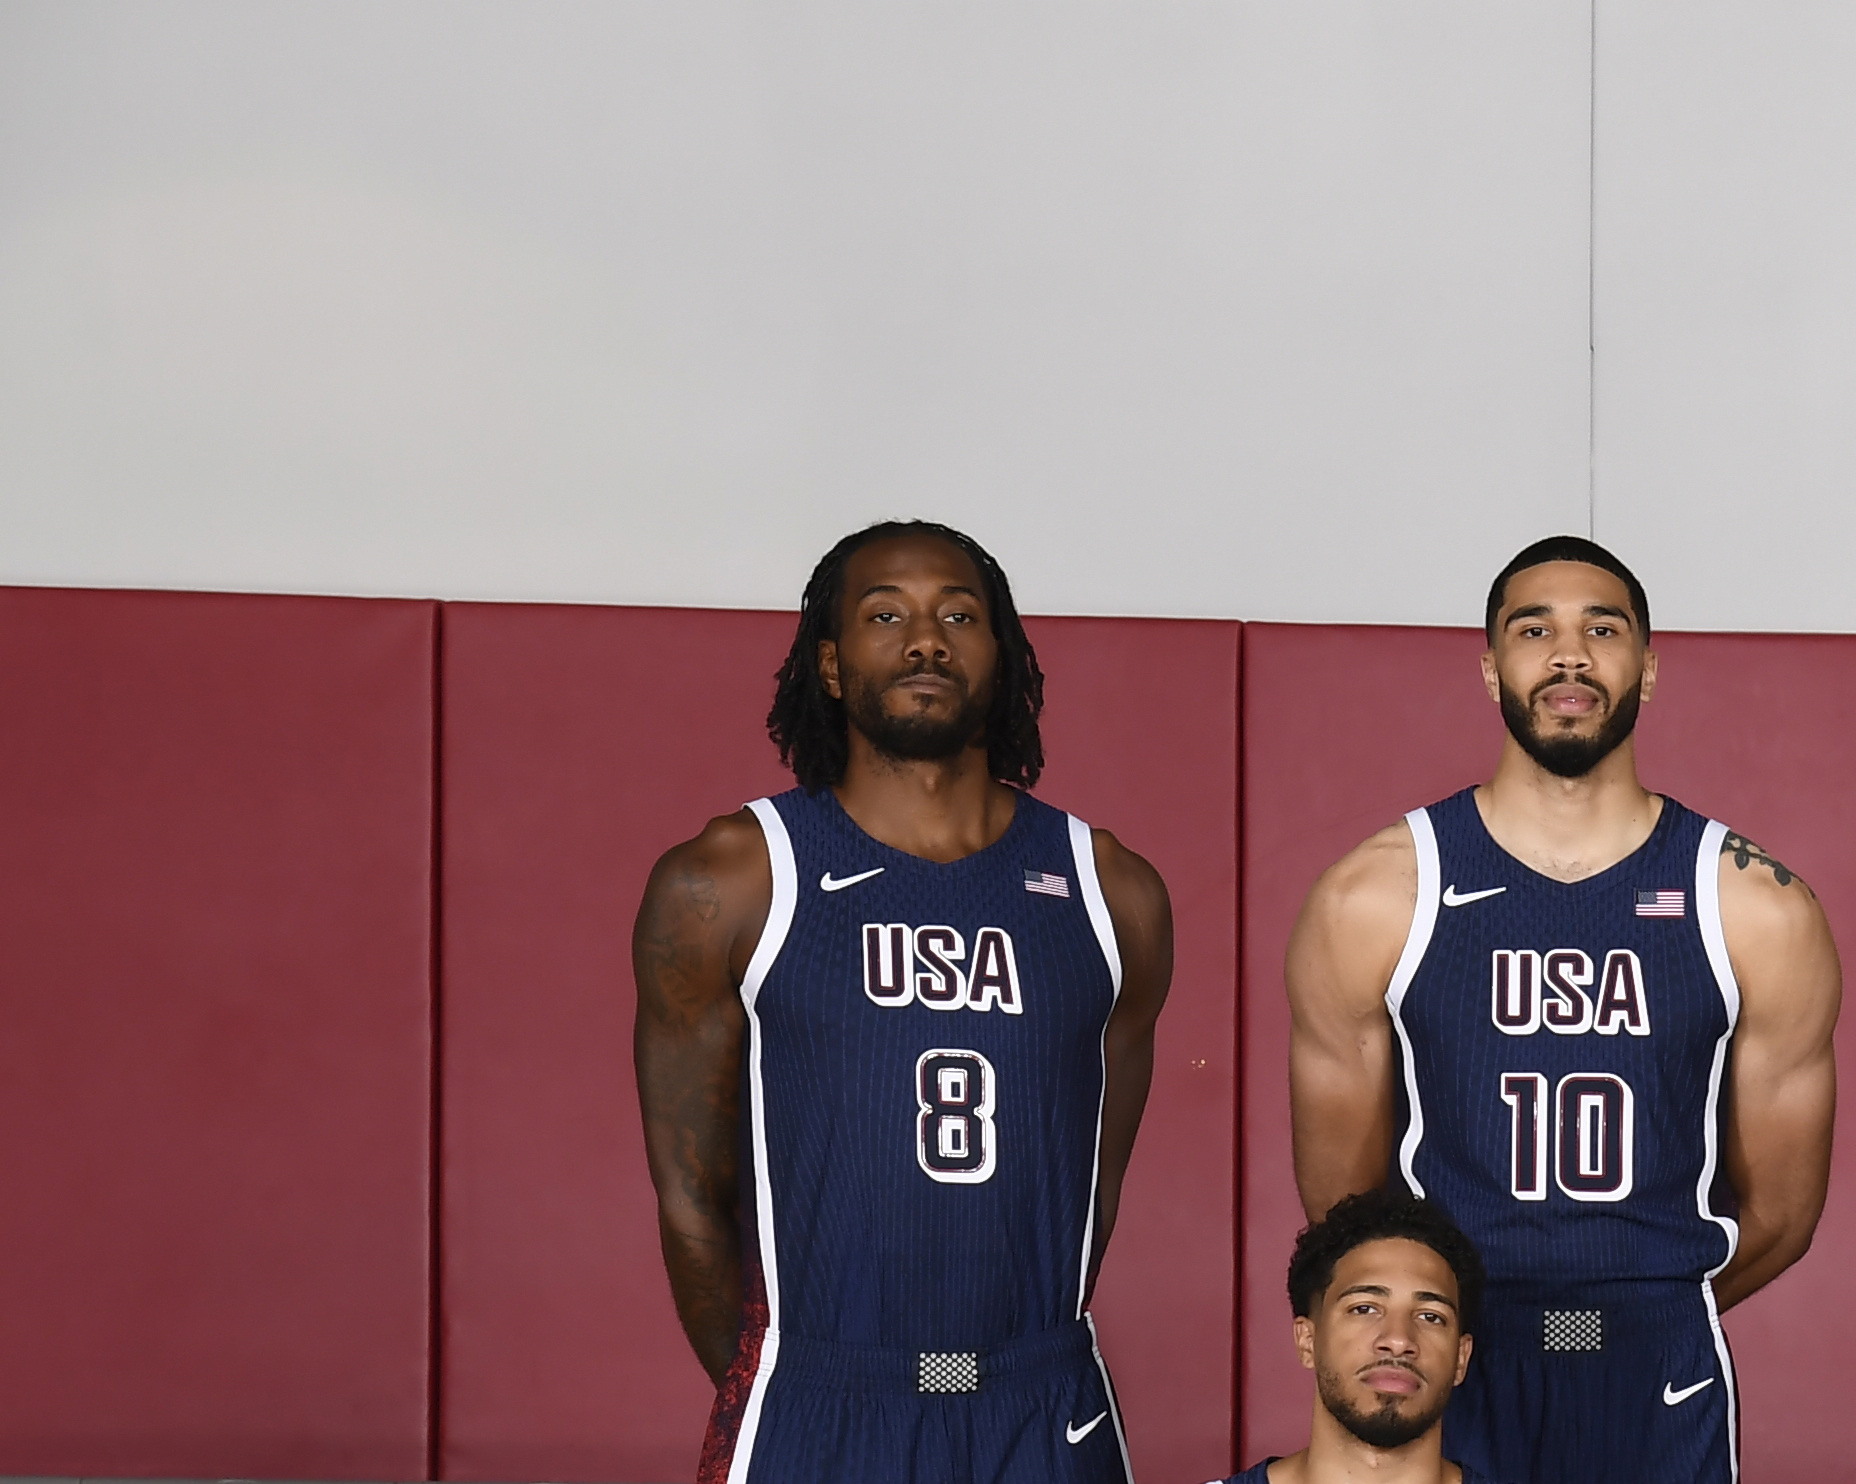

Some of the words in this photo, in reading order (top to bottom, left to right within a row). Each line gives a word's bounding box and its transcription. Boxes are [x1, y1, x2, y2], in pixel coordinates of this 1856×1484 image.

[862, 923, 1024, 1015] USA
[1491, 948, 1651, 1036] USA
[915, 1048, 997, 1184] 8
[1500, 1072, 1634, 1202] 10
